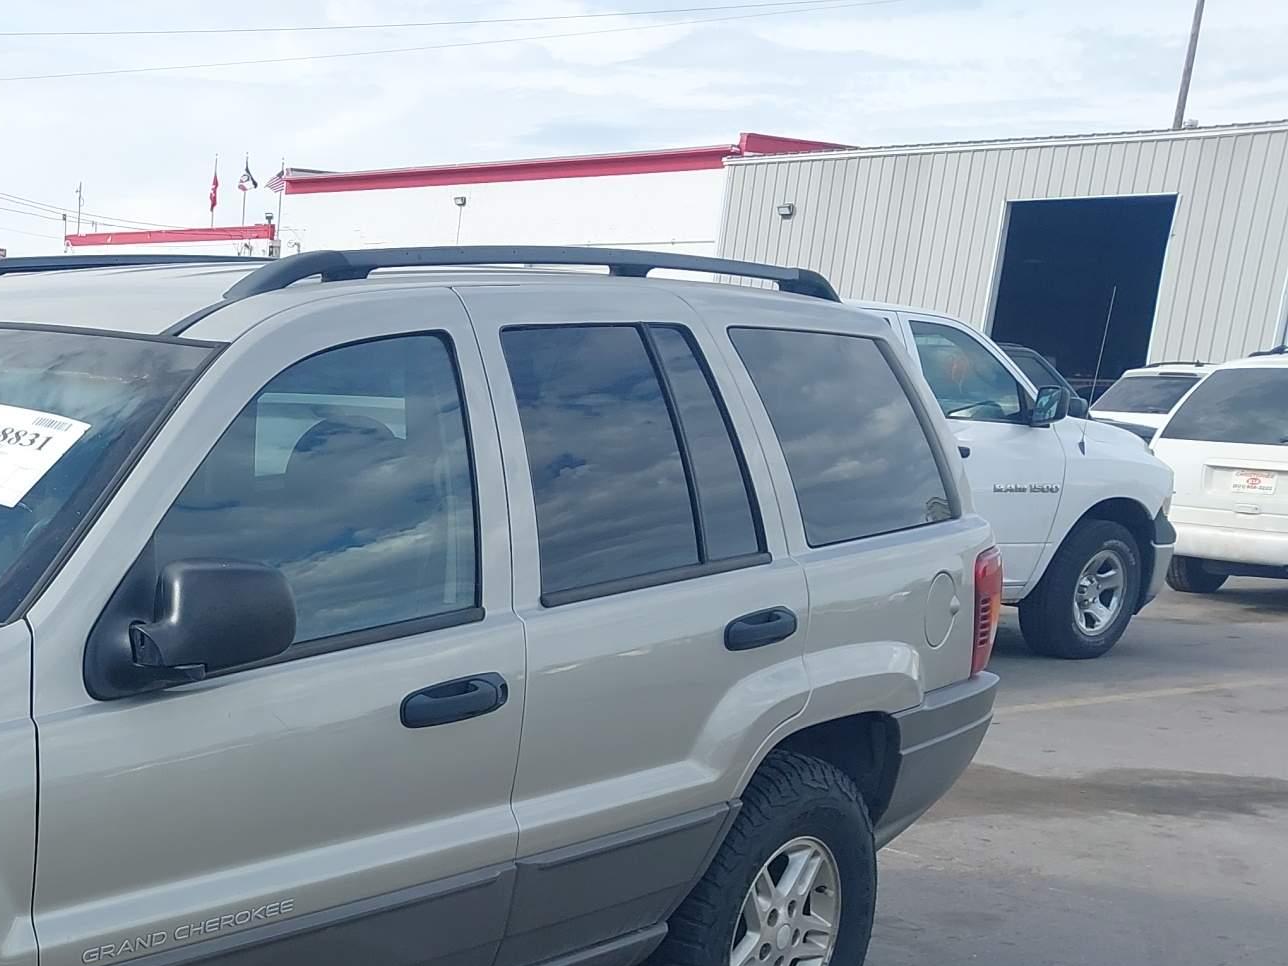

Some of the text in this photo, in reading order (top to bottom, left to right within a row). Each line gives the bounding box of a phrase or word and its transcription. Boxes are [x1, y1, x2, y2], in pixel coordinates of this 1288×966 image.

[1029, 483, 1060, 494] 1500
[81, 898, 295, 964] GRAND CHEROKEE
